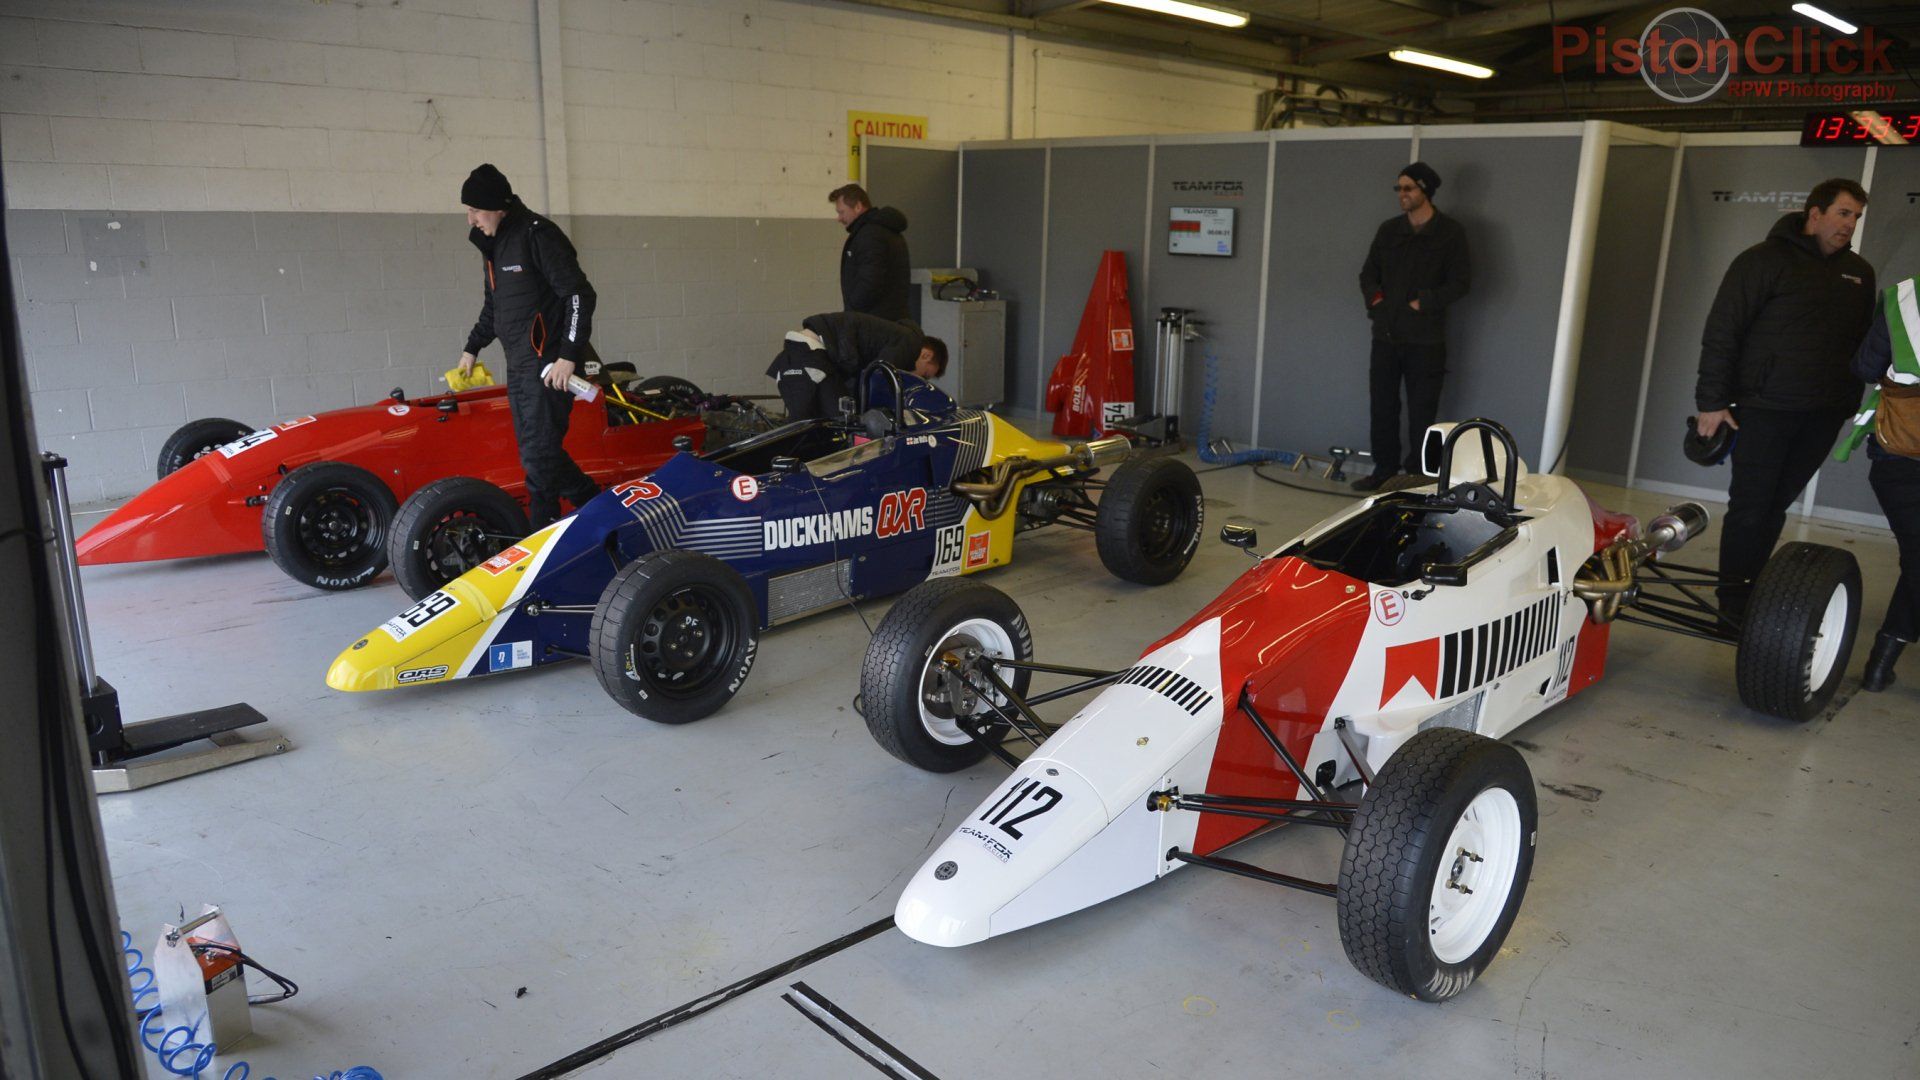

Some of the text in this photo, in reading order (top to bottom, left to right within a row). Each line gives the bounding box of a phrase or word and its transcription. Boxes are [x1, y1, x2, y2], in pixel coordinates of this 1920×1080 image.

[854, 119, 922, 139] CAUTION
[764, 506, 874, 551] DUCKHAMS
[875, 487, 927, 539] QXR
[936, 525, 964, 566] 169
[1553, 635, 1576, 690] 112
[979, 777, 1063, 841] 112
